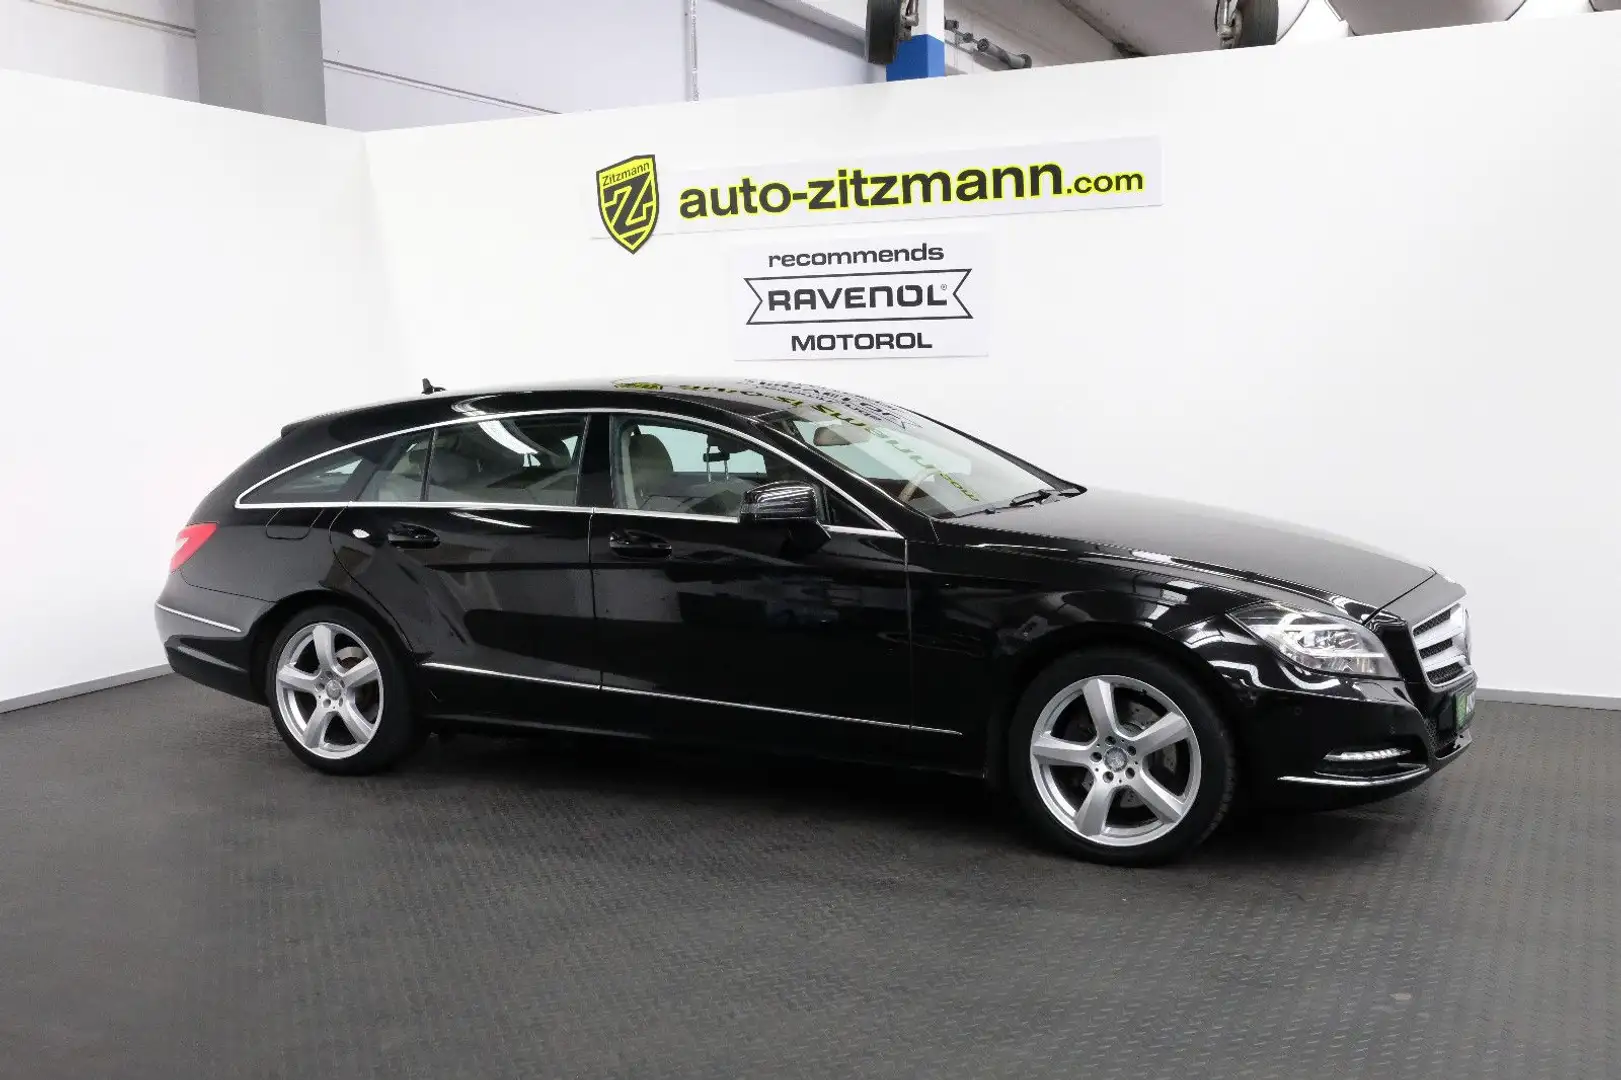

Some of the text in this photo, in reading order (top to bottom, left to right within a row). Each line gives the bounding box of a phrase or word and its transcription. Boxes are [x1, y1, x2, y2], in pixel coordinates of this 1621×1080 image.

[602, 162, 650, 187] Zitzmann
[679, 162, 1145, 219] auto-zitzmann.com
[768, 243, 945, 268] recommends
[791, 332, 933, 352] MOTOROL
